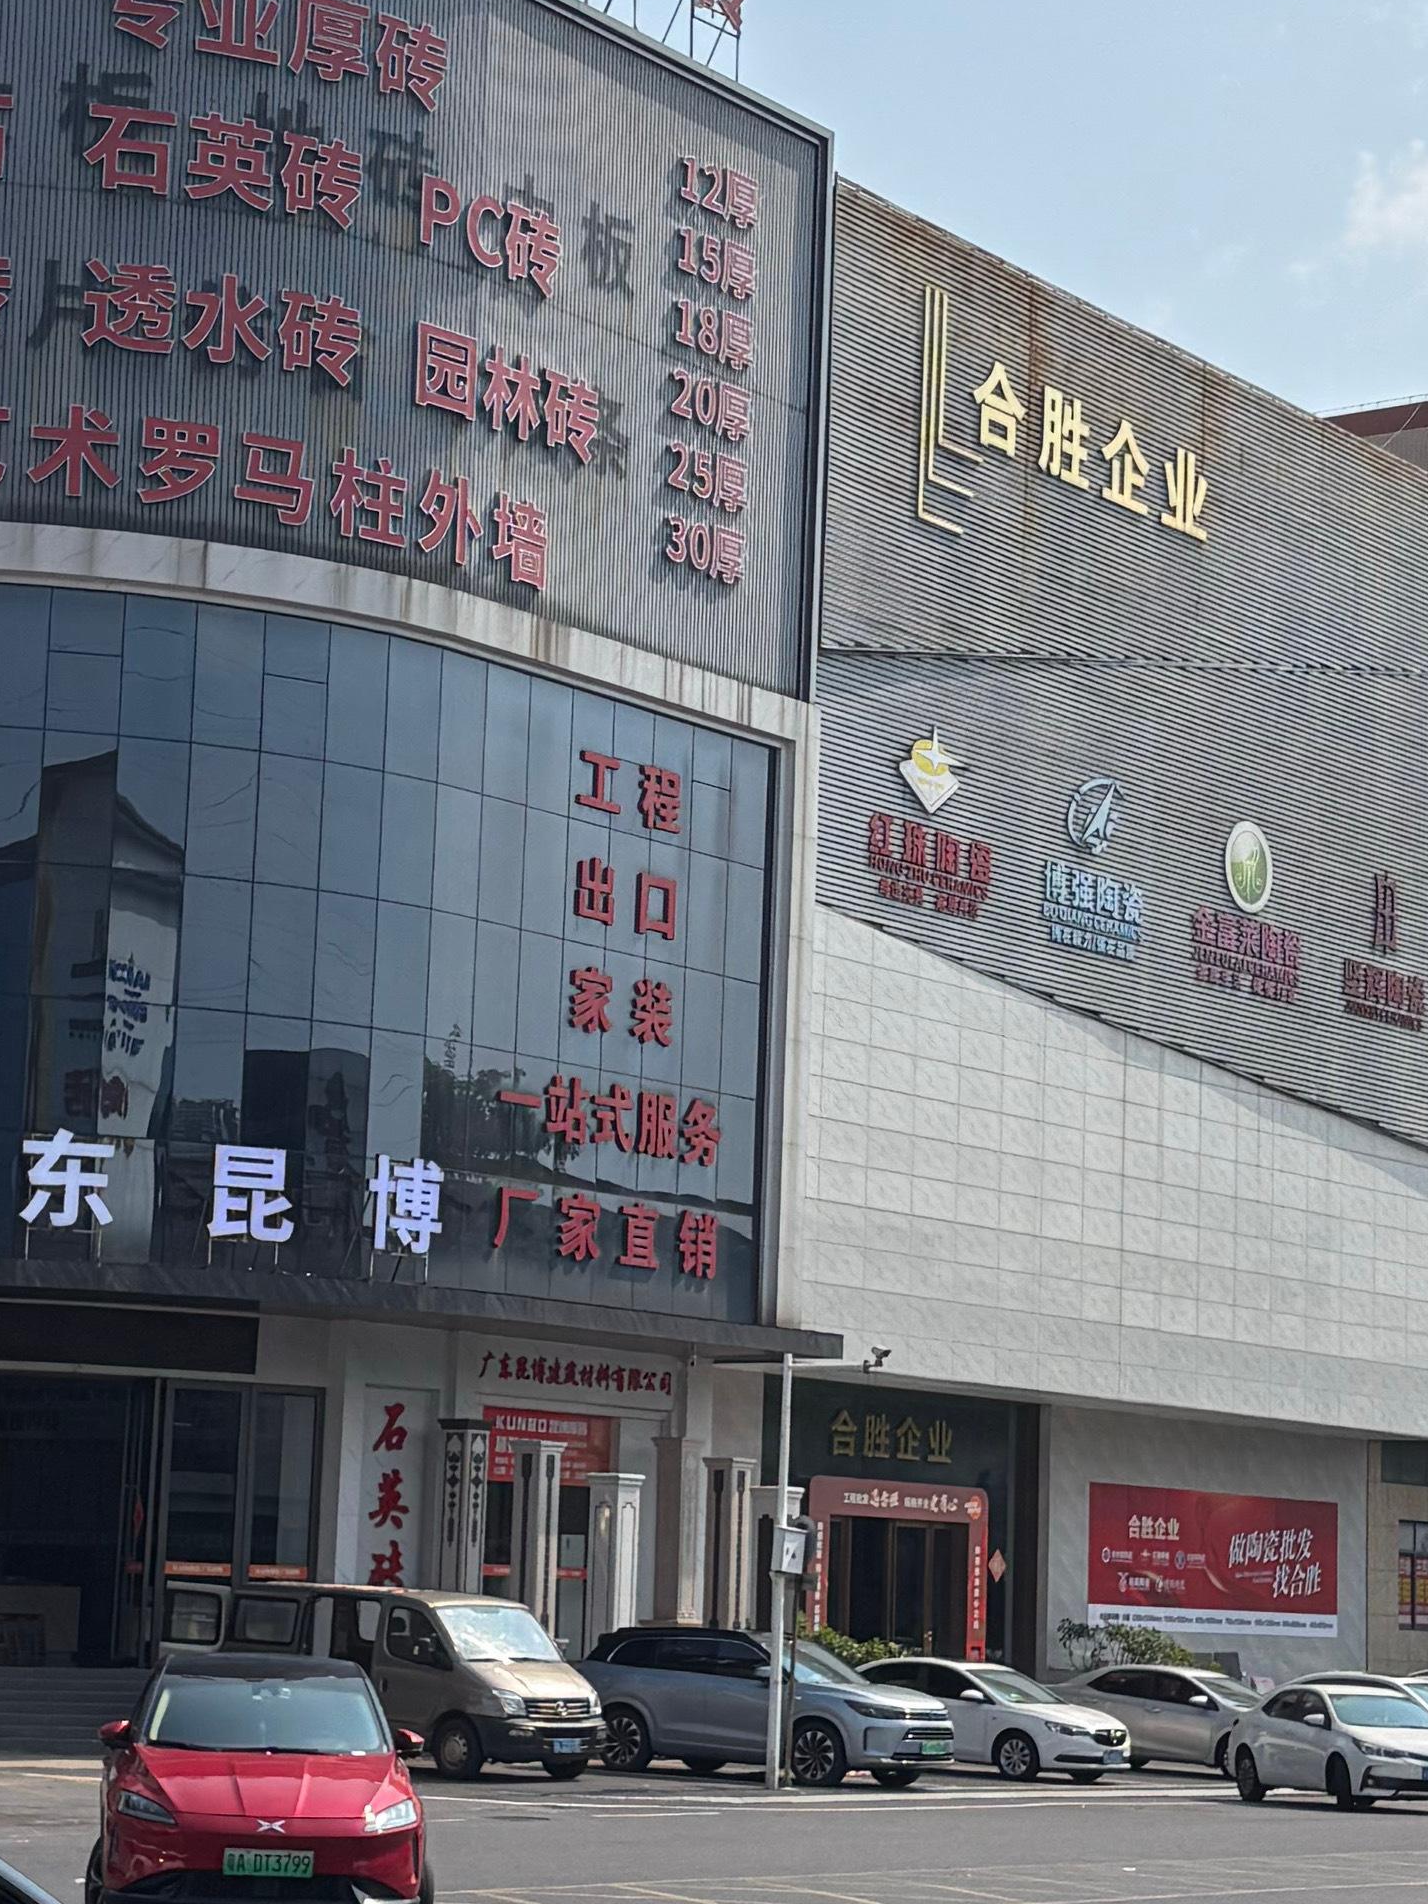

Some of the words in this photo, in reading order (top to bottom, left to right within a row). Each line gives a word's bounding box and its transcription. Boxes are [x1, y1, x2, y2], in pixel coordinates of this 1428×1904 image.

[83, 102, 363, 231] 石英砖
[420, 173, 562, 299] PC砖
[680, 155, 759, 229] 12厚
[677, 227, 756, 299] 15厚
[81, 257, 363, 389] 透水砖
[416, 320, 600, 466] 园林砖
[676, 299, 754, 371] 18厚
[671, 369, 752, 442] 20厚
[668, 442, 750, 514] 25厚
[973, 361, 1209, 542] 合胜企业
[666, 516, 746, 584] 30厚
[575, 750, 683, 834] 工程
[573, 856, 678, 940] 出口
[1044, 859, 1143, 924] 博强陶瓷
[569, 966, 673, 1048] 家装
[499, 1073, 724, 1167] 一站式服务
[493, 1185, 719, 1280] 厂家直销
[832, 1409, 952, 1464] 合胜企业
[1128, 1514, 1180, 1540] 合胜企业
[1228, 1528, 1313, 1568] 做陶瓷批发
[1273, 1562, 1322, 1598] 找合胜
